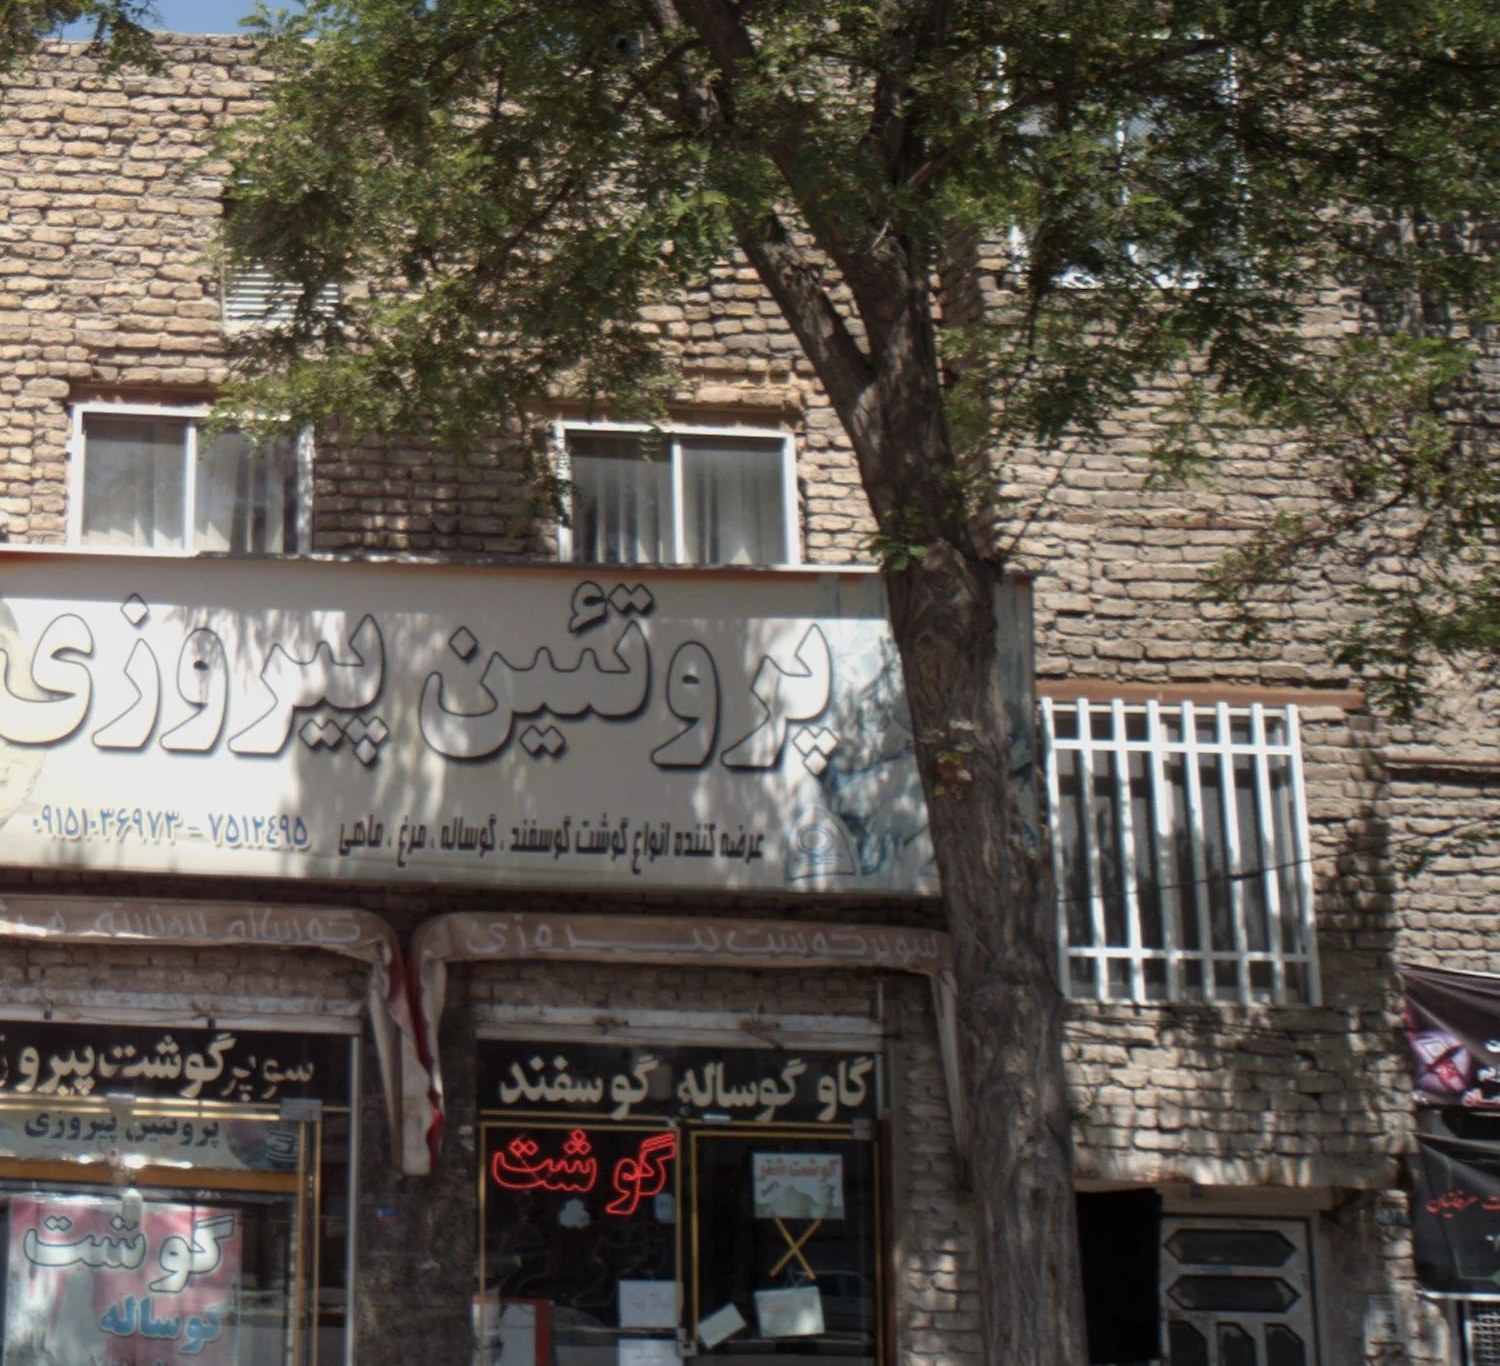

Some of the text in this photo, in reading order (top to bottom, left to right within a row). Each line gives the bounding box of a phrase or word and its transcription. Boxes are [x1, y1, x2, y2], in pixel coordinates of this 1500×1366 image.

[418, 580, 839, 778] پروتئین
[338, 813, 384, 857] ماهی
[397, 815, 428, 868] مرغ
[440, 813, 497, 858] گوساله
[510, 815, 572, 862] گوسفند
[576, 811, 629, 863] گوشت
[631, 821, 671, 876] انواع
[674, 822, 717, 857] کننده
[720, 823, 764, 865] عرضه
[99, 1032, 238, 1098] گوشت
[500, 1054, 875, 1123] گاو گوساله گوسفند
[24, 1110, 119, 1144] پیروزی
[491, 1128, 678, 1218] گوشت
[22, 1212, 236, 1294] گوشت
